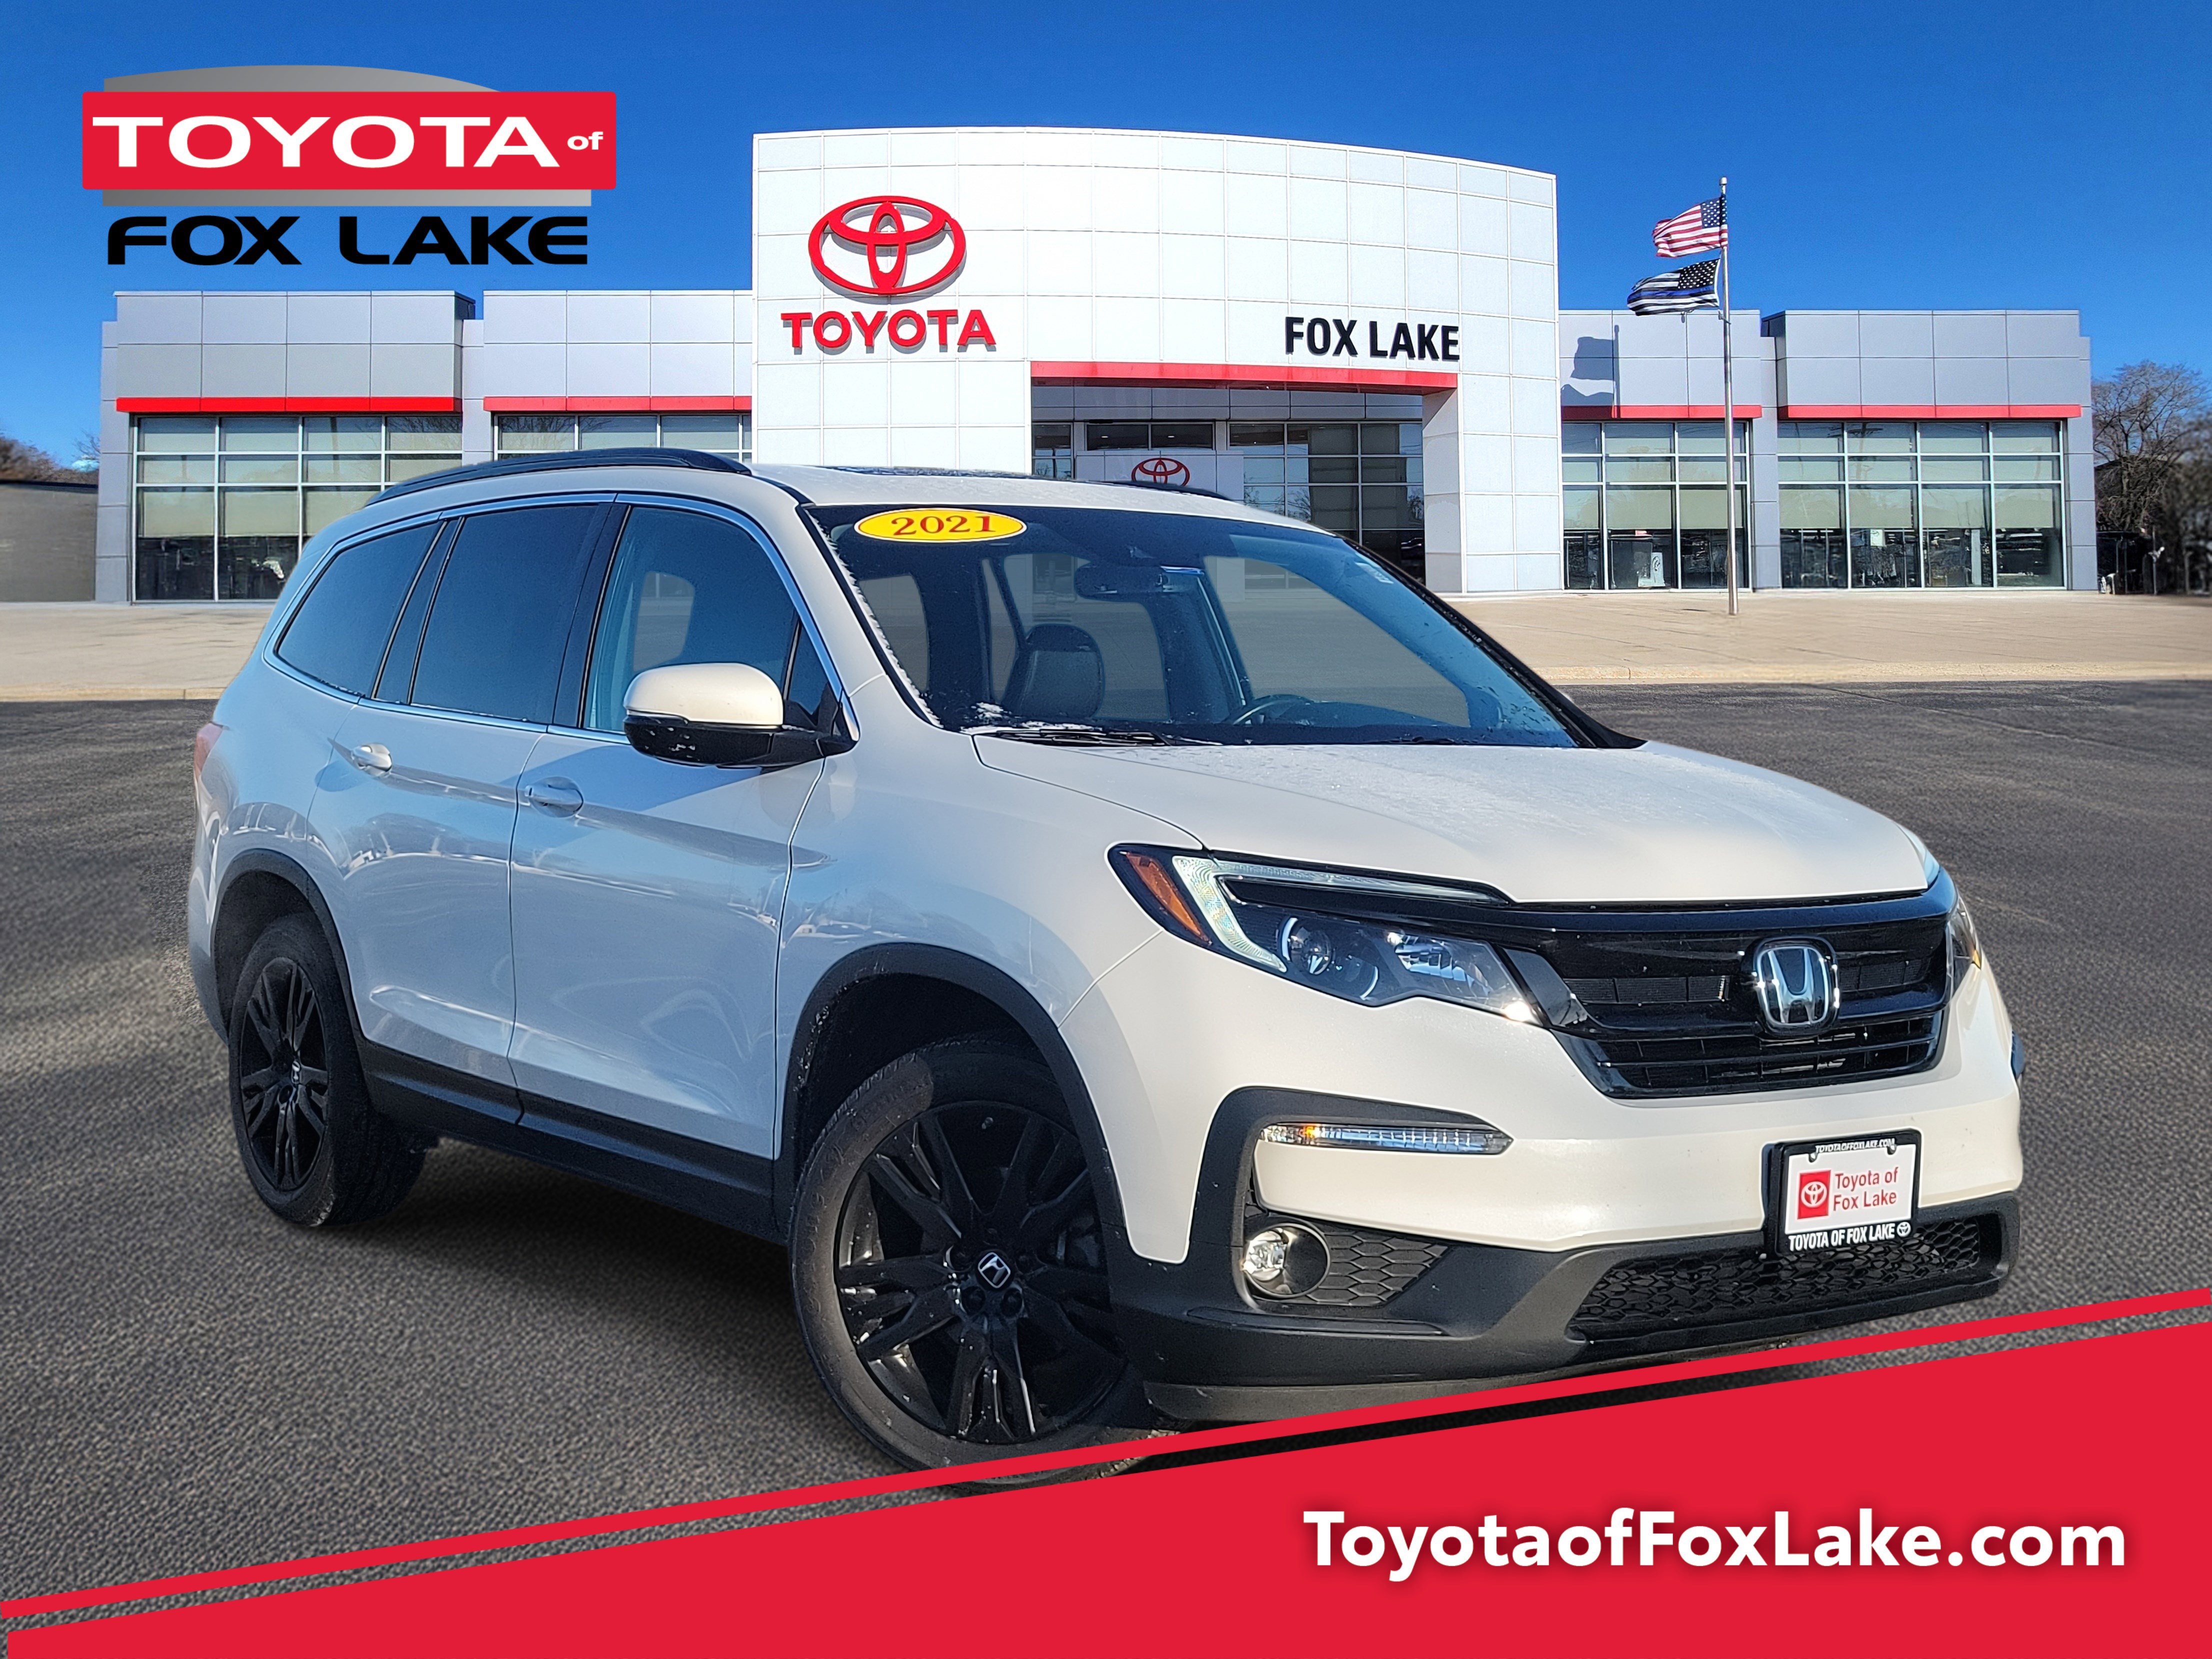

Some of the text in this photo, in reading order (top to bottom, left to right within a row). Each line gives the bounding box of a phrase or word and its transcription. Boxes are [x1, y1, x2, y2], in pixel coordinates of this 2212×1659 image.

[781, 309, 996, 350] TOYOTA
[1286, 316, 1460, 361] FOX LAKE
[891, 515, 996, 536] 2021
[1834, 1166, 1898, 1192] Toyota of
[1833, 1189, 1896, 1211] Fox Lake
[1788, 1223, 1896, 1252] TOYOTA OF FOX LAKE
